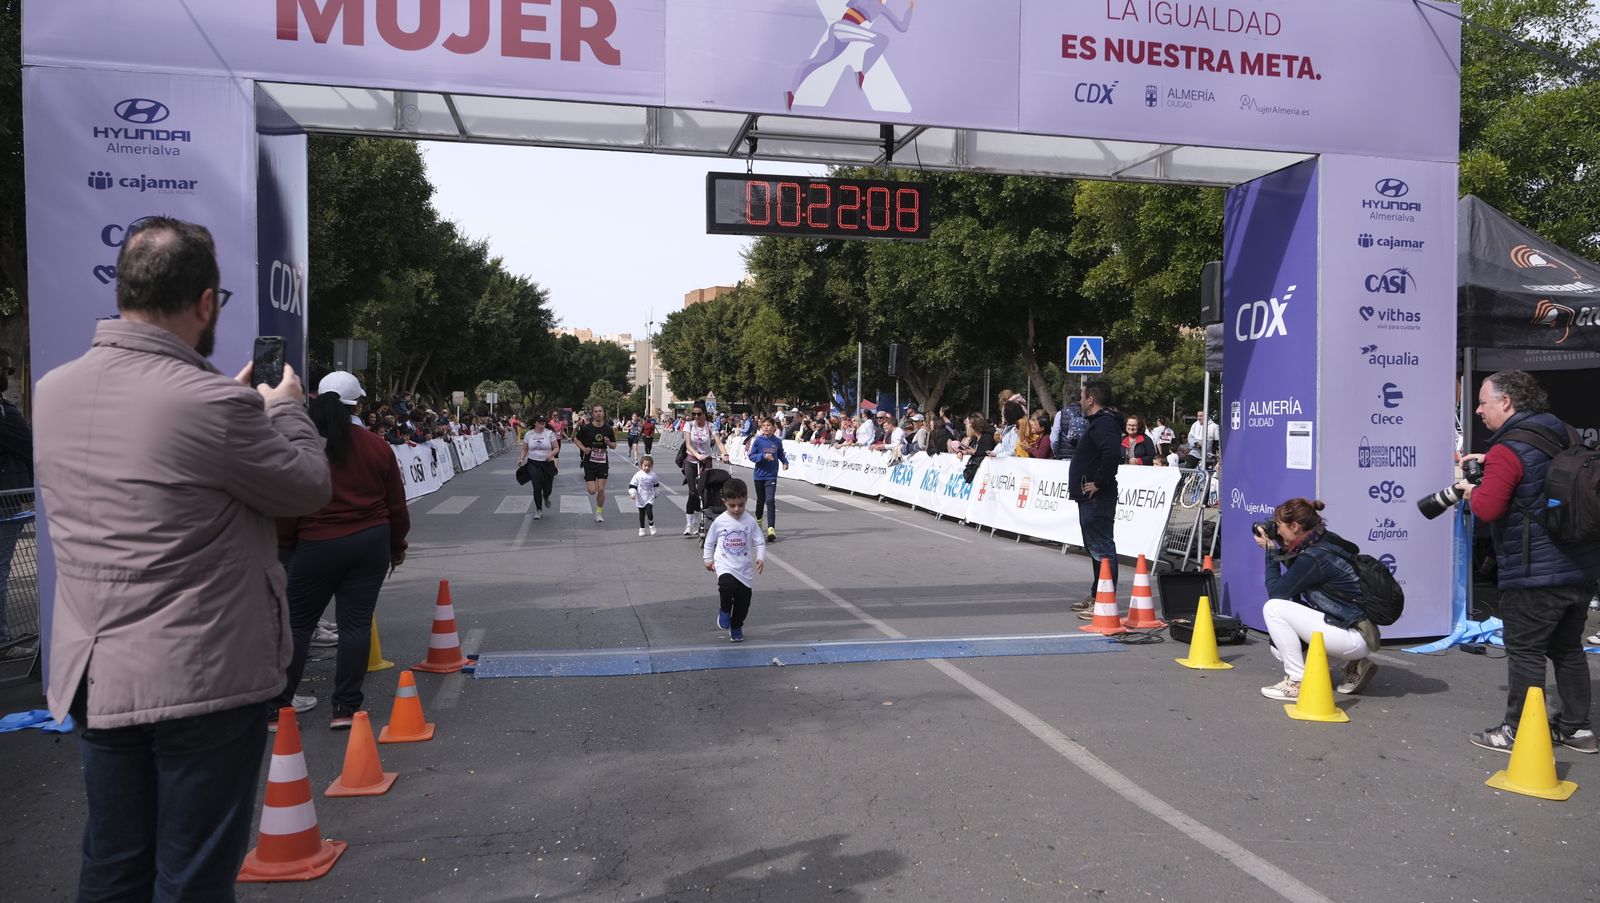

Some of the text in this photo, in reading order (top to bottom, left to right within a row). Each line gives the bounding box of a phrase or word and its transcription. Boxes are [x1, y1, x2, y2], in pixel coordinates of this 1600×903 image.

[1106, 0, 1281, 36] LA IGUALDAD
[276, 0, 621, 66] MUJER
[1061, 34, 1322, 80] ES NUESTRA META.
[1074, 80, 1119, 105] CDX
[1167, 87, 1215, 102] ALMERÍA
[1166, 100, 1192, 109] CIUDAD
[93, 126, 191, 142] HYUNDAI
[106, 142, 180, 156] Almerialva
[118, 173, 198, 192] cajamar
[745, 180, 919, 232] 00:22:08
[1362, 199, 1421, 212] HYUNDAI
[1370, 211, 1415, 223] Almerialva
[1377, 236, 1424, 250] cajamar
[270, 260, 301, 316] CDX
[1364, 273, 1406, 294] CASI
[1235, 285, 1297, 342] CDX
[1378, 308, 1421, 322] vithas
[1369, 352, 1419, 368] aqualia
[1248, 397, 1302, 415] ALMERÍA
[1248, 417, 1274, 428] CIUDAD
[1371, 413, 1403, 425] Clece
[1389, 445, 1416, 467] CASH
[1037, 479, 1069, 499] ALME
[1117, 485, 1166, 509] LMERÍA
[1368, 480, 1405, 504] ego
[1367, 528, 1408, 542] Lanjarón
